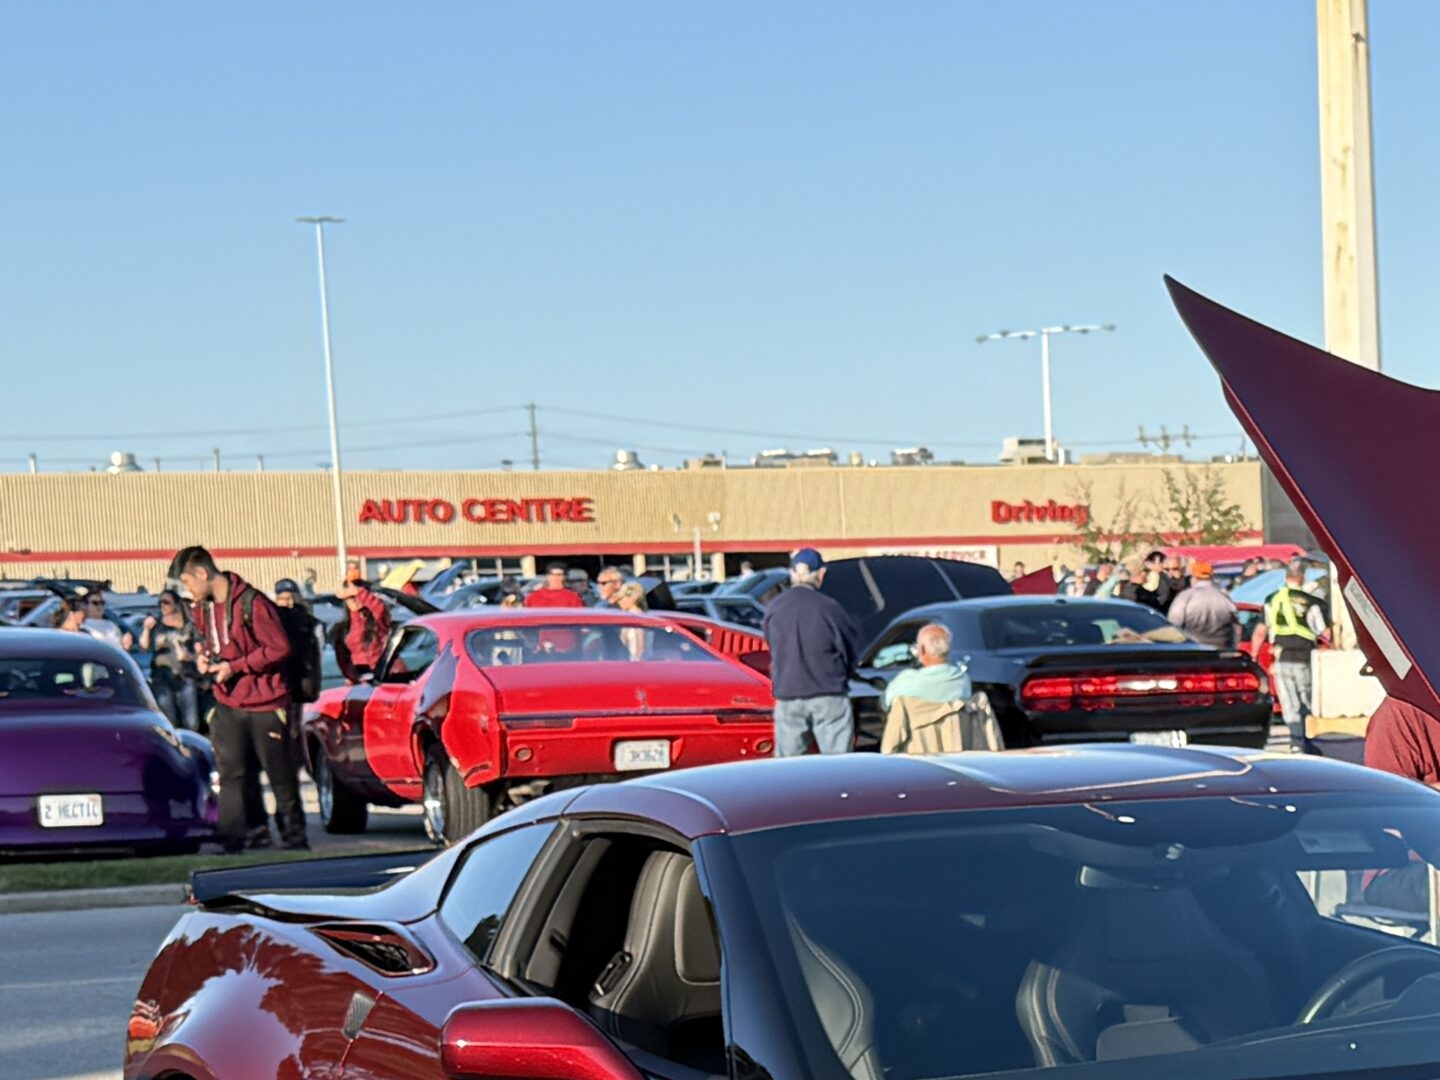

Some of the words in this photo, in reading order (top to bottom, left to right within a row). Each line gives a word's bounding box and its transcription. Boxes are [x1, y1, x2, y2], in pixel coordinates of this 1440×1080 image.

[359, 498, 455, 524] AUTO
[461, 497, 595, 523] CENTRE
[990, 499, 1090, 529] Driving
